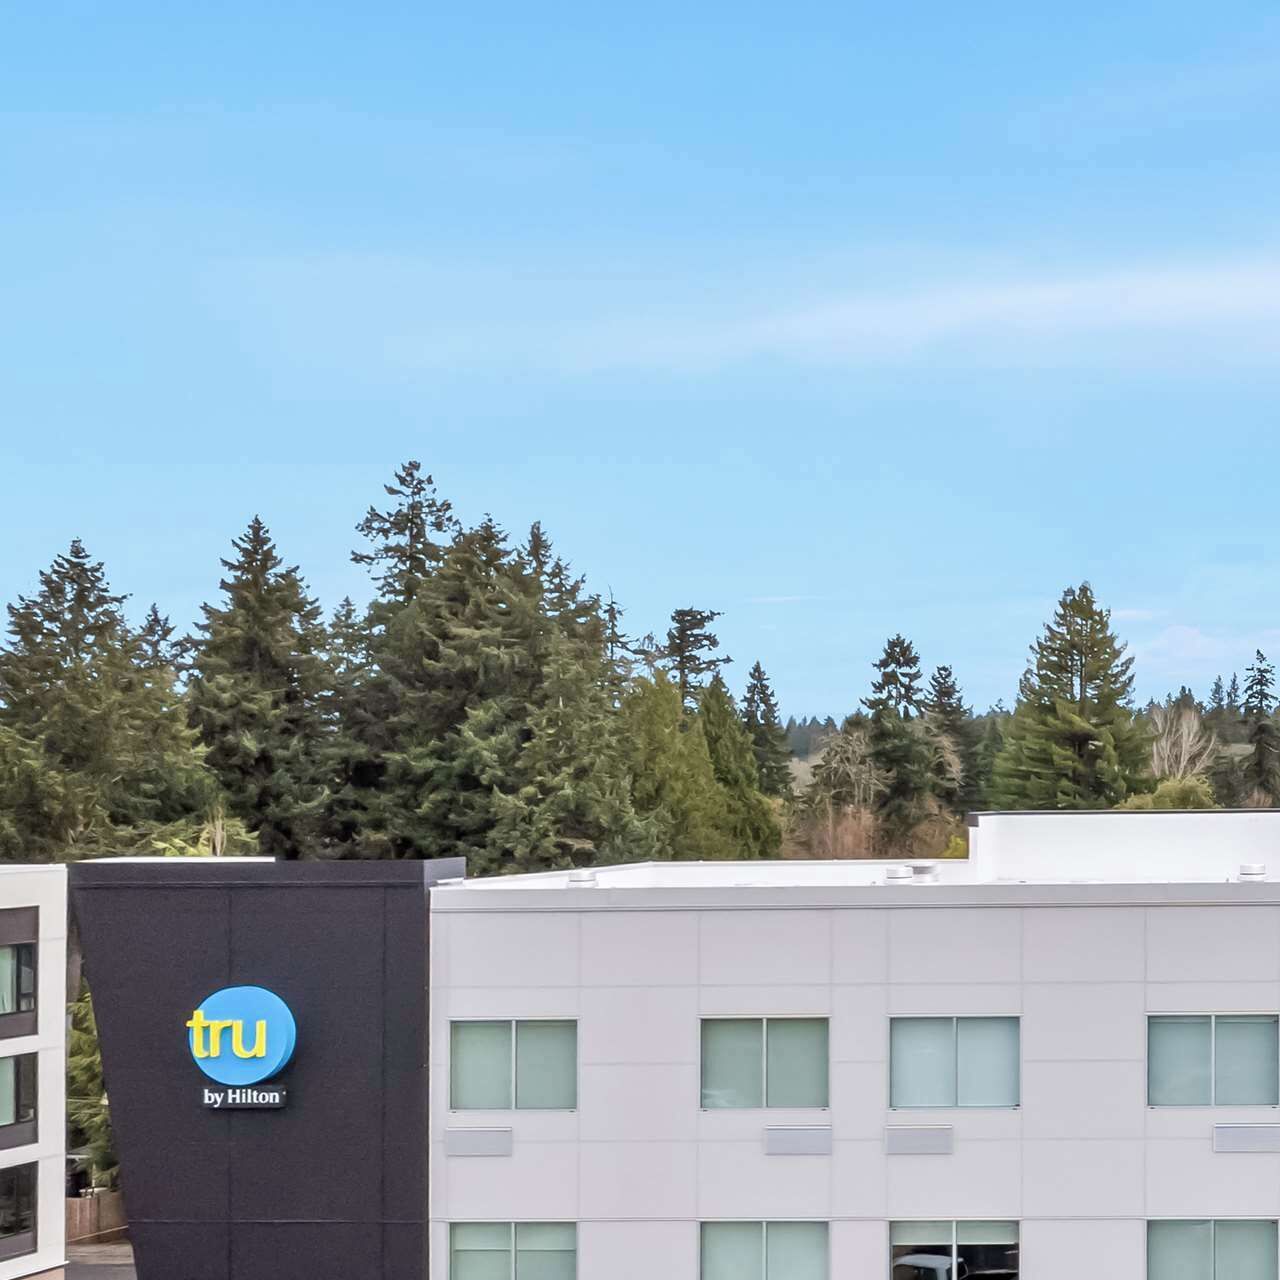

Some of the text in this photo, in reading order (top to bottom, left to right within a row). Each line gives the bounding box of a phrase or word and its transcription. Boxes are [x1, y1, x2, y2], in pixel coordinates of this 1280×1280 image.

[186, 1009, 267, 1059] tru
[203, 1088, 280, 1108] by Hilton
